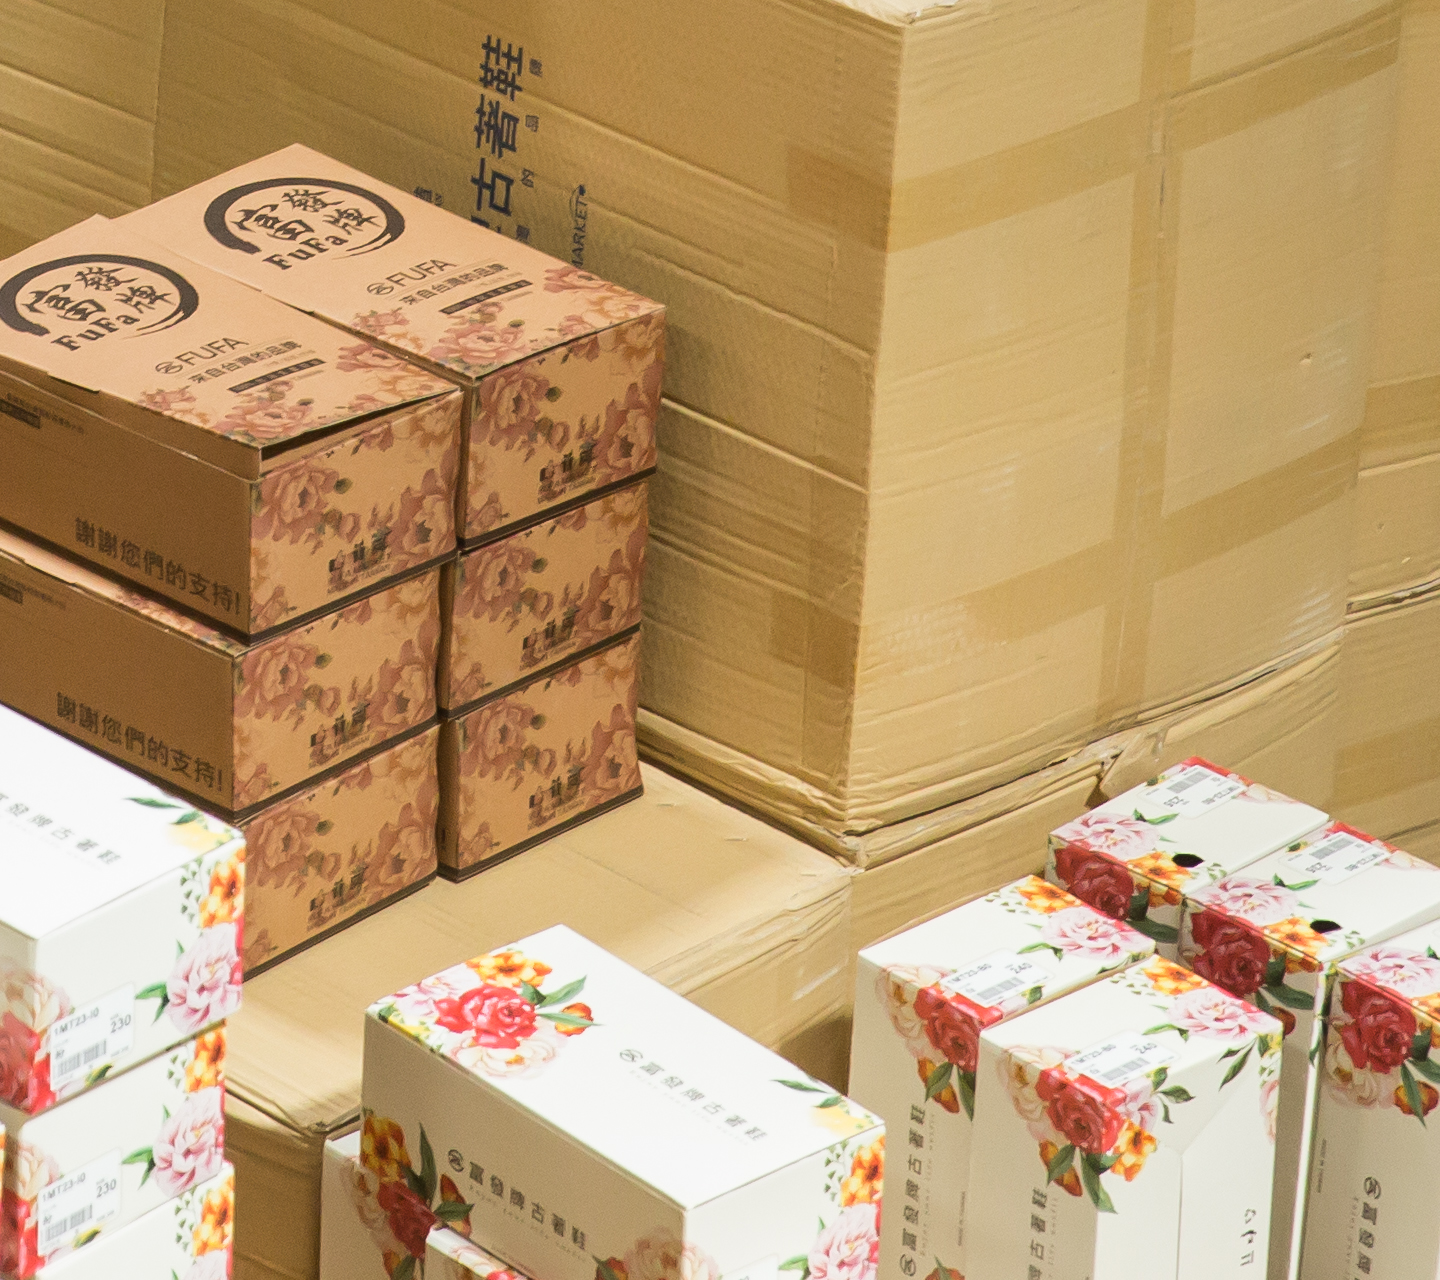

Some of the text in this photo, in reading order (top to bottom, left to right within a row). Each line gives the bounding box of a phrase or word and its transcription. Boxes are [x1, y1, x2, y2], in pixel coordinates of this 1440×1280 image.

[472, 35, 522, 217] 古著鞋
[229, 189, 382, 241] 富發牌
[263, 231, 350, 270] FuFa
[22, 266, 171, 321] 富發牌
[388, 259, 457, 289] FUFA
[51, 314, 141, 352] FuFa
[178, 337, 249, 367] FUFA
[110, 1014, 132, 1034] 230
[639, 1060, 767, 1141] 富發牌古著鞋
[95, 1179, 117, 1200] 230
[903, 1105, 927, 1251] 富發牌古著鞋
[469, 1161, 586, 1251] 富發牌古著鞋
